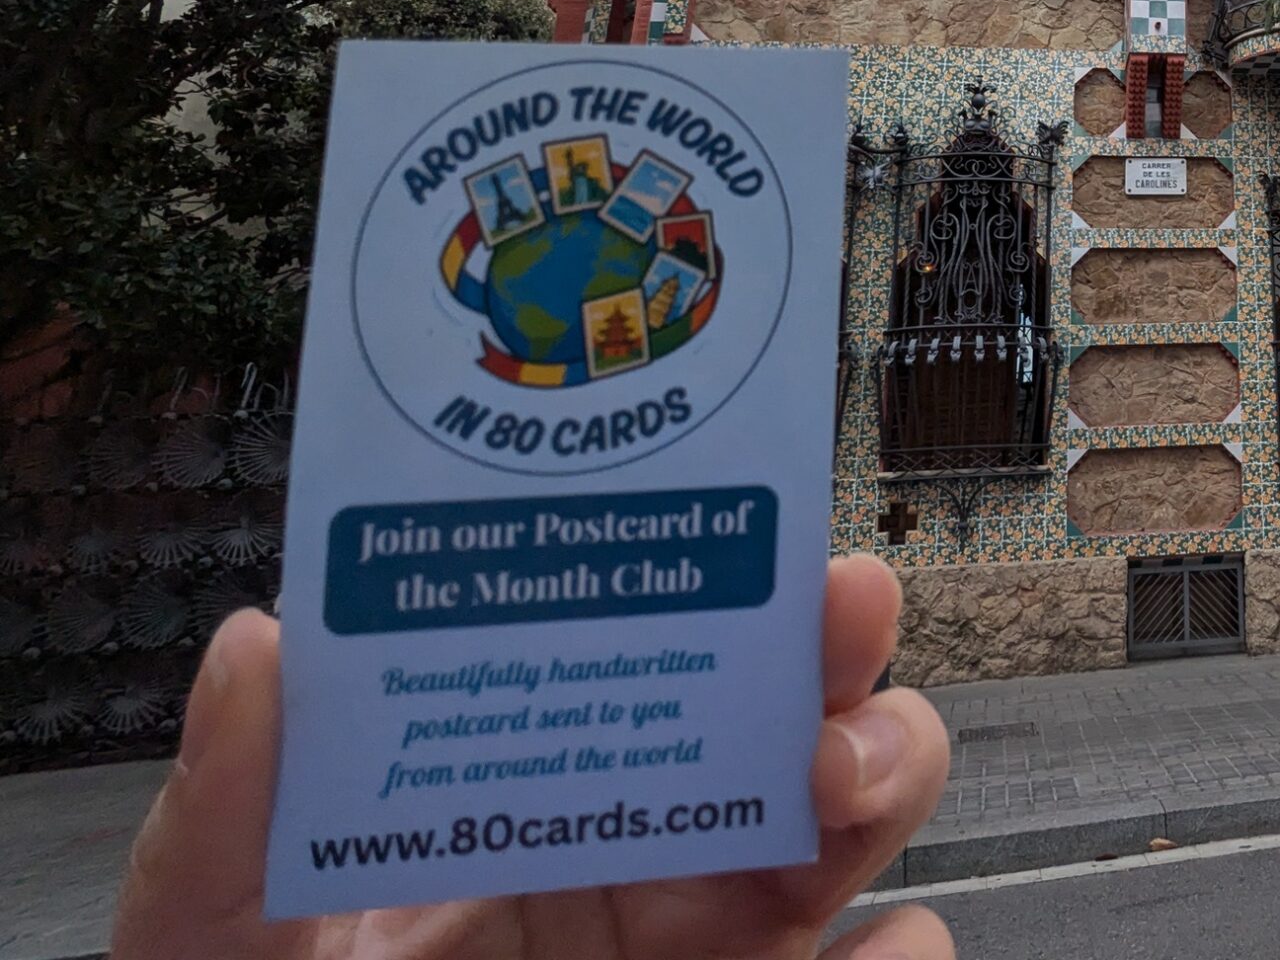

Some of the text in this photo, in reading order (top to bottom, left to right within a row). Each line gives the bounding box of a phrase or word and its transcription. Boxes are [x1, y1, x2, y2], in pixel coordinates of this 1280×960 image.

[401, 87, 764, 204] AROUND THE WORLD
[1135, 179, 1178, 189] CAROLINES
[1156, 170, 1171, 178] LES
[433, 388, 693, 457] IN 80 CARDS
[359, 500, 755, 563] Join our Postcard of
[395, 559, 702, 612] the Month Club
[381, 649, 717, 696] Beautifully handwritten
[401, 699, 682, 749] postcard sent to you
[377, 739, 702, 799] from around the world
[310, 796, 765, 872] www.80cards.com
